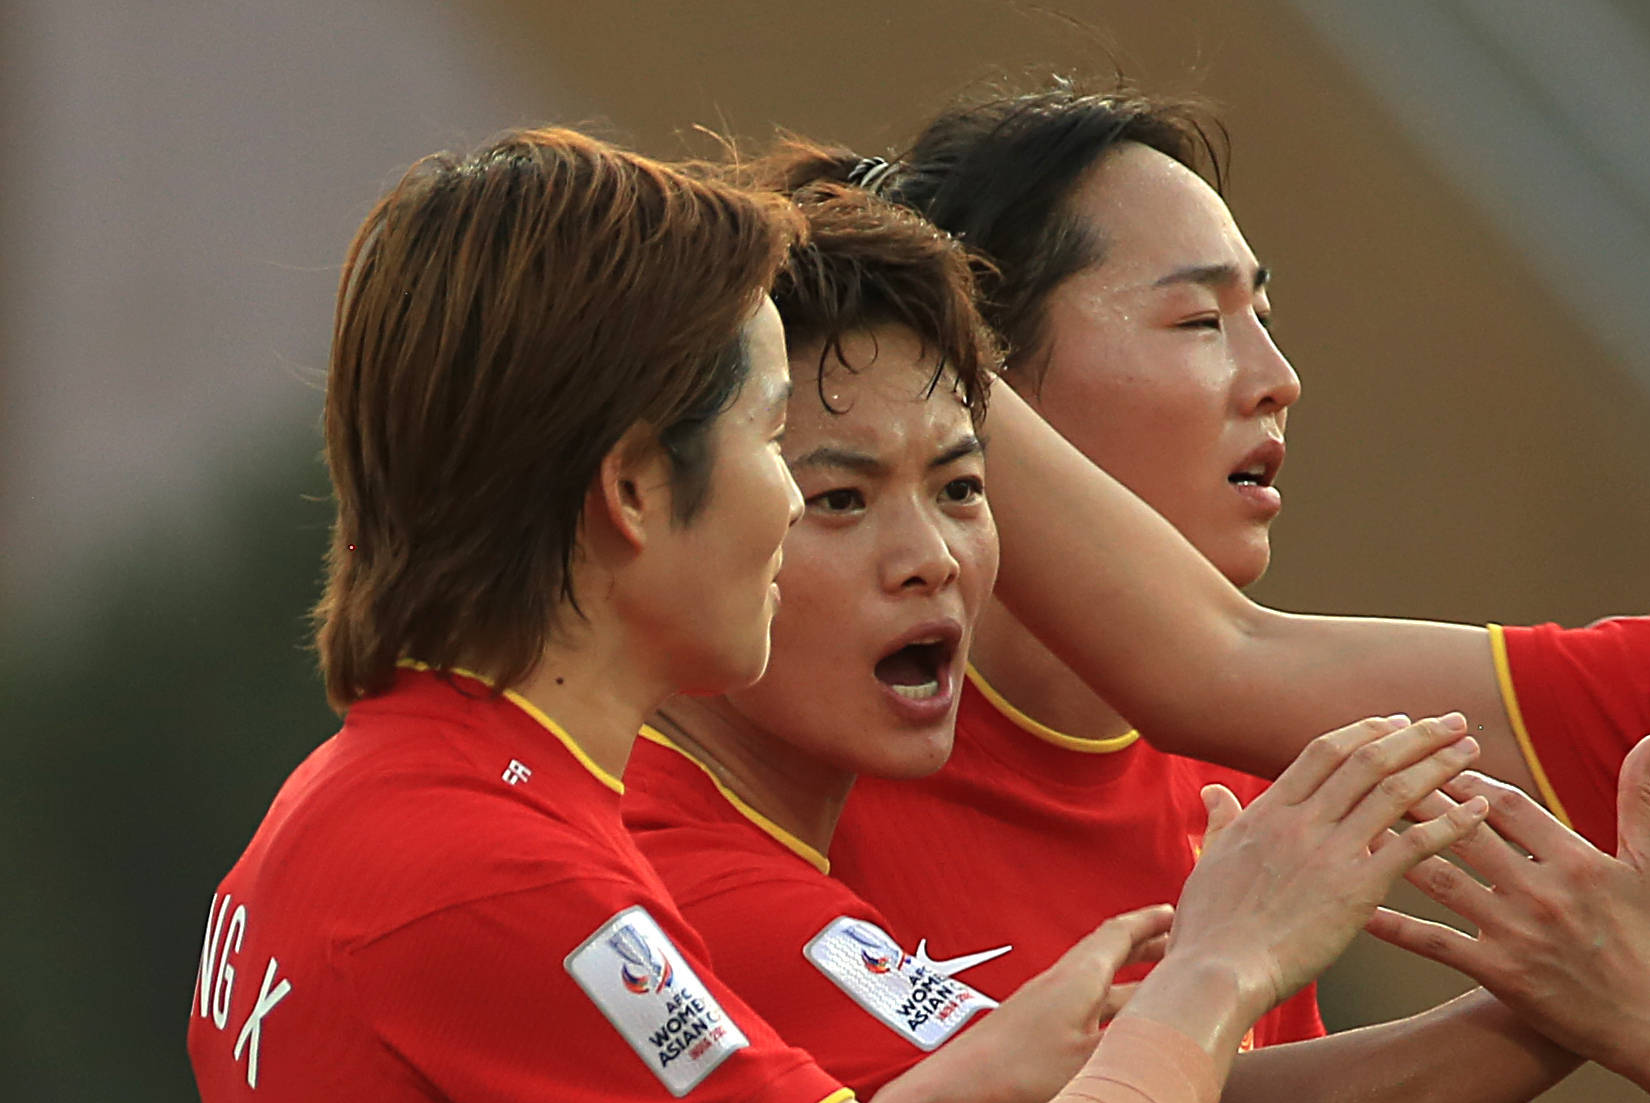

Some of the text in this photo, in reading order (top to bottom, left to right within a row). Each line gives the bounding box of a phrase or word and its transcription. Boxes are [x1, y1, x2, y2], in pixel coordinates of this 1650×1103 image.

[234, 956, 292, 1090] K
[666, 987, 692, 1014] AFC
[907, 985, 953, 1031] ASIAN
[659, 1018, 708, 1068] ASIAN
